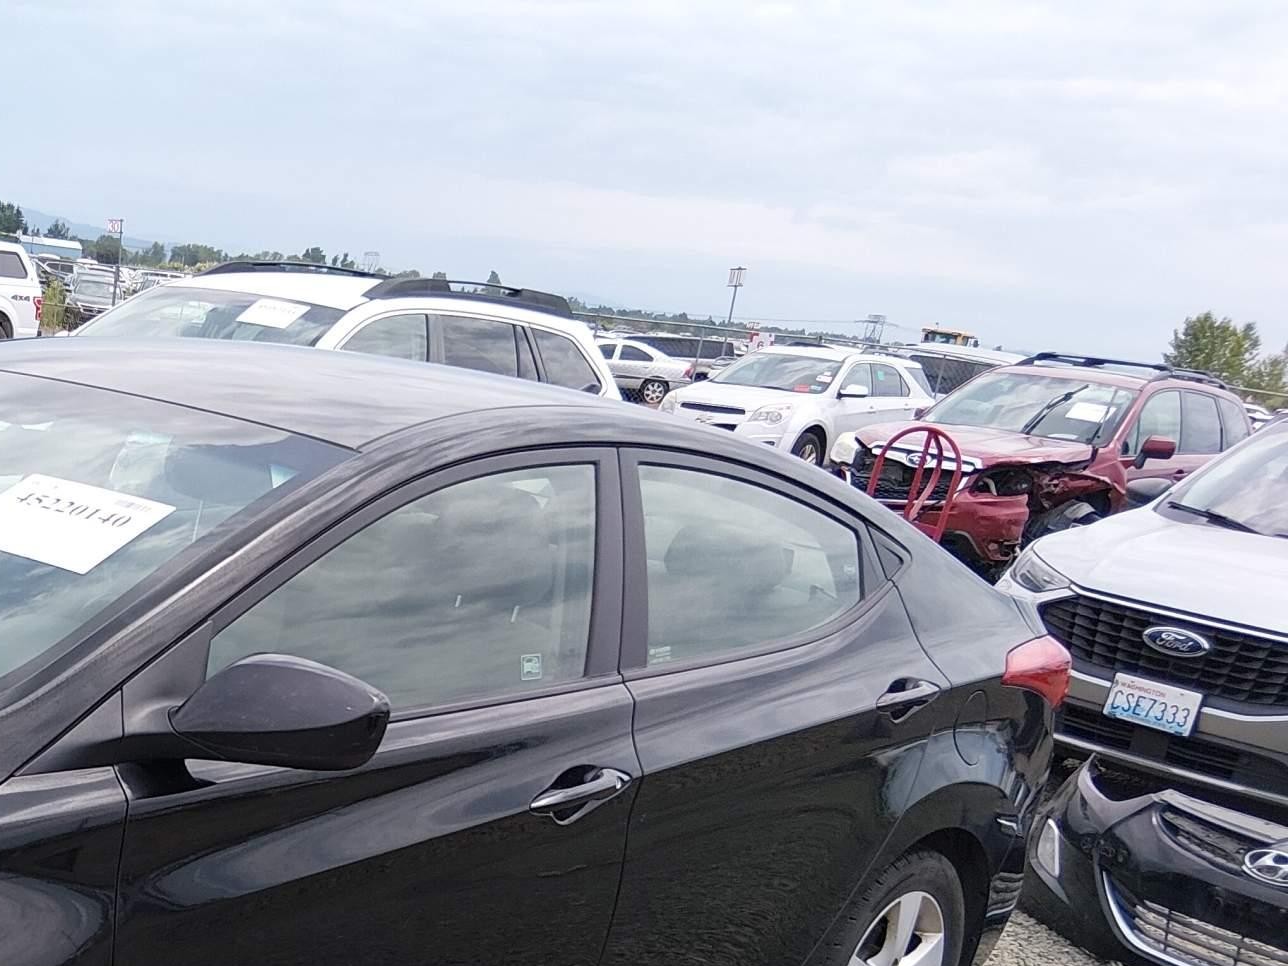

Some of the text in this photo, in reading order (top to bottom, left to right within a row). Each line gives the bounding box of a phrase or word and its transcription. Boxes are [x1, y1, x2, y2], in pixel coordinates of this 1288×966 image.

[16, 492, 132, 528] 45220140
[1120, 681, 1167, 698] WASHINGTON
[1110, 690, 1191, 728] CSE7333
